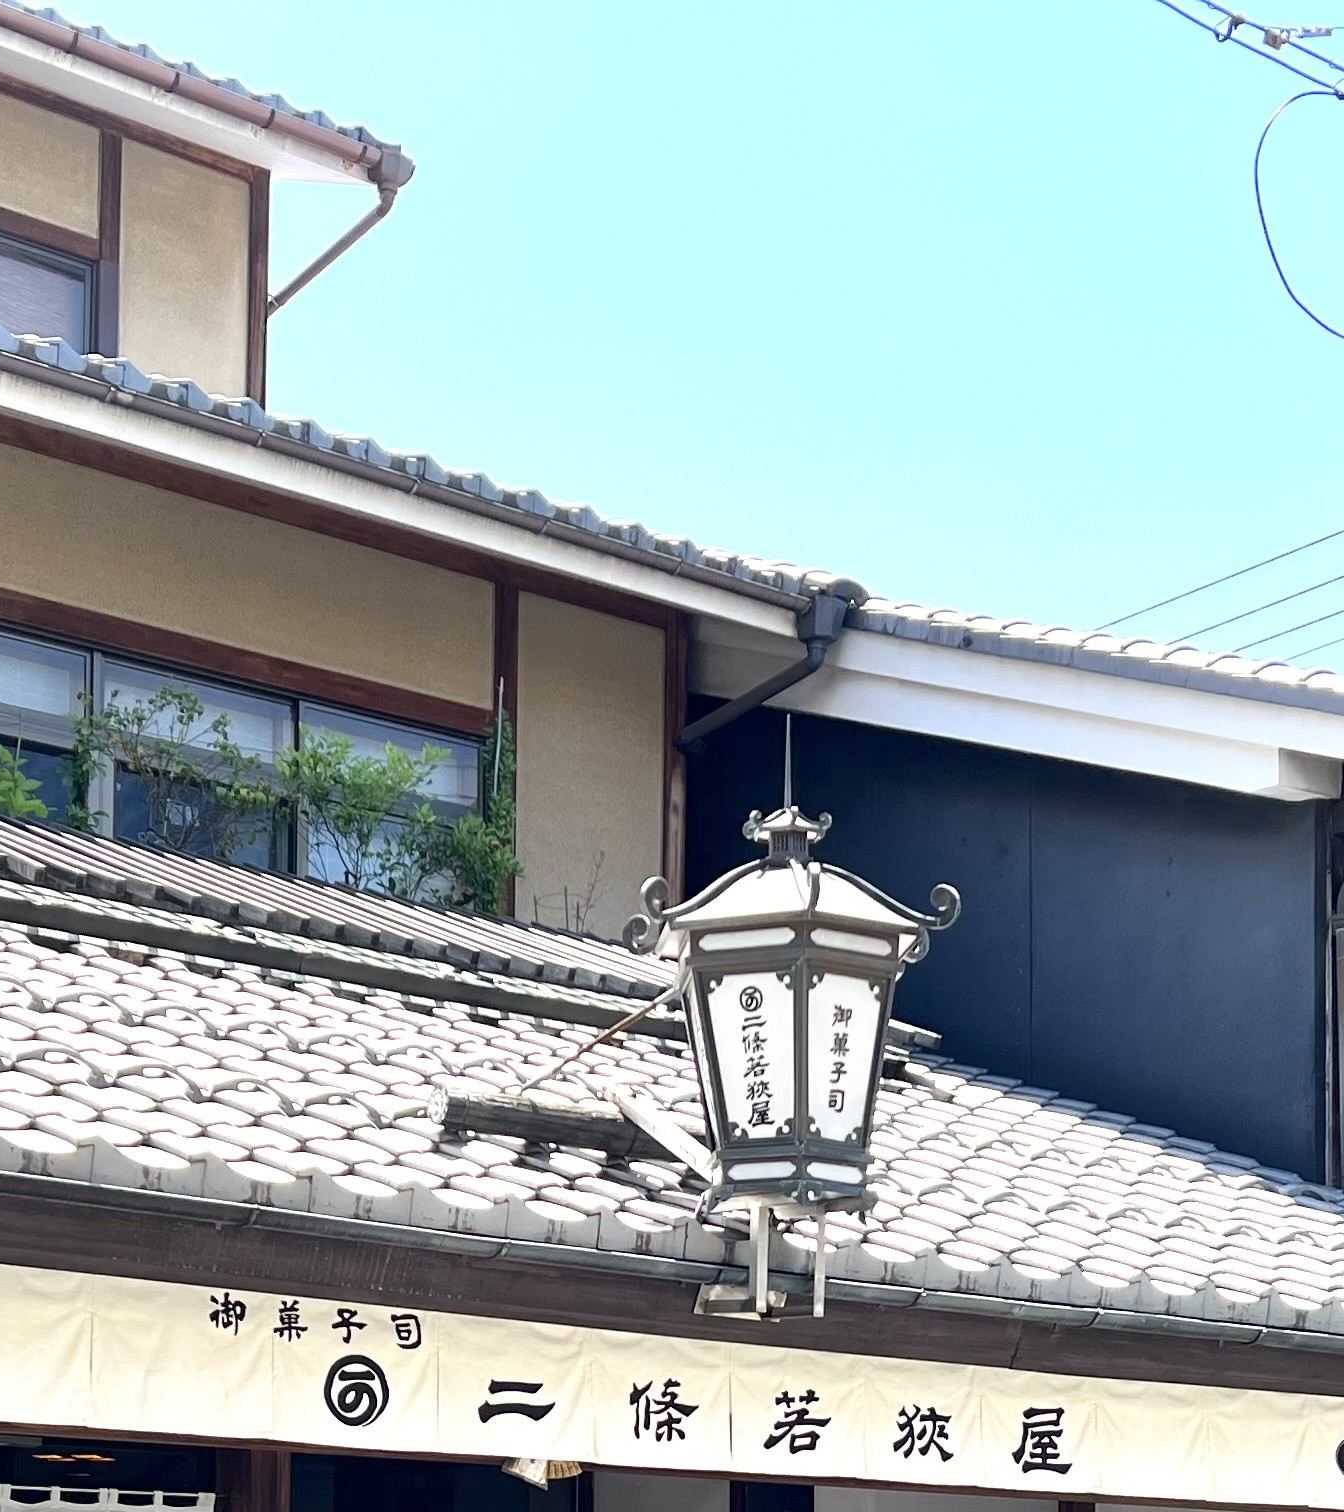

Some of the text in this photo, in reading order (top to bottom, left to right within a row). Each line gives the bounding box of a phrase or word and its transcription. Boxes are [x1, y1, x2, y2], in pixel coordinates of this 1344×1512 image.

[828, 1004, 853, 1114] 御菓子司
[208, 1293, 425, 1349] 御菓子司
